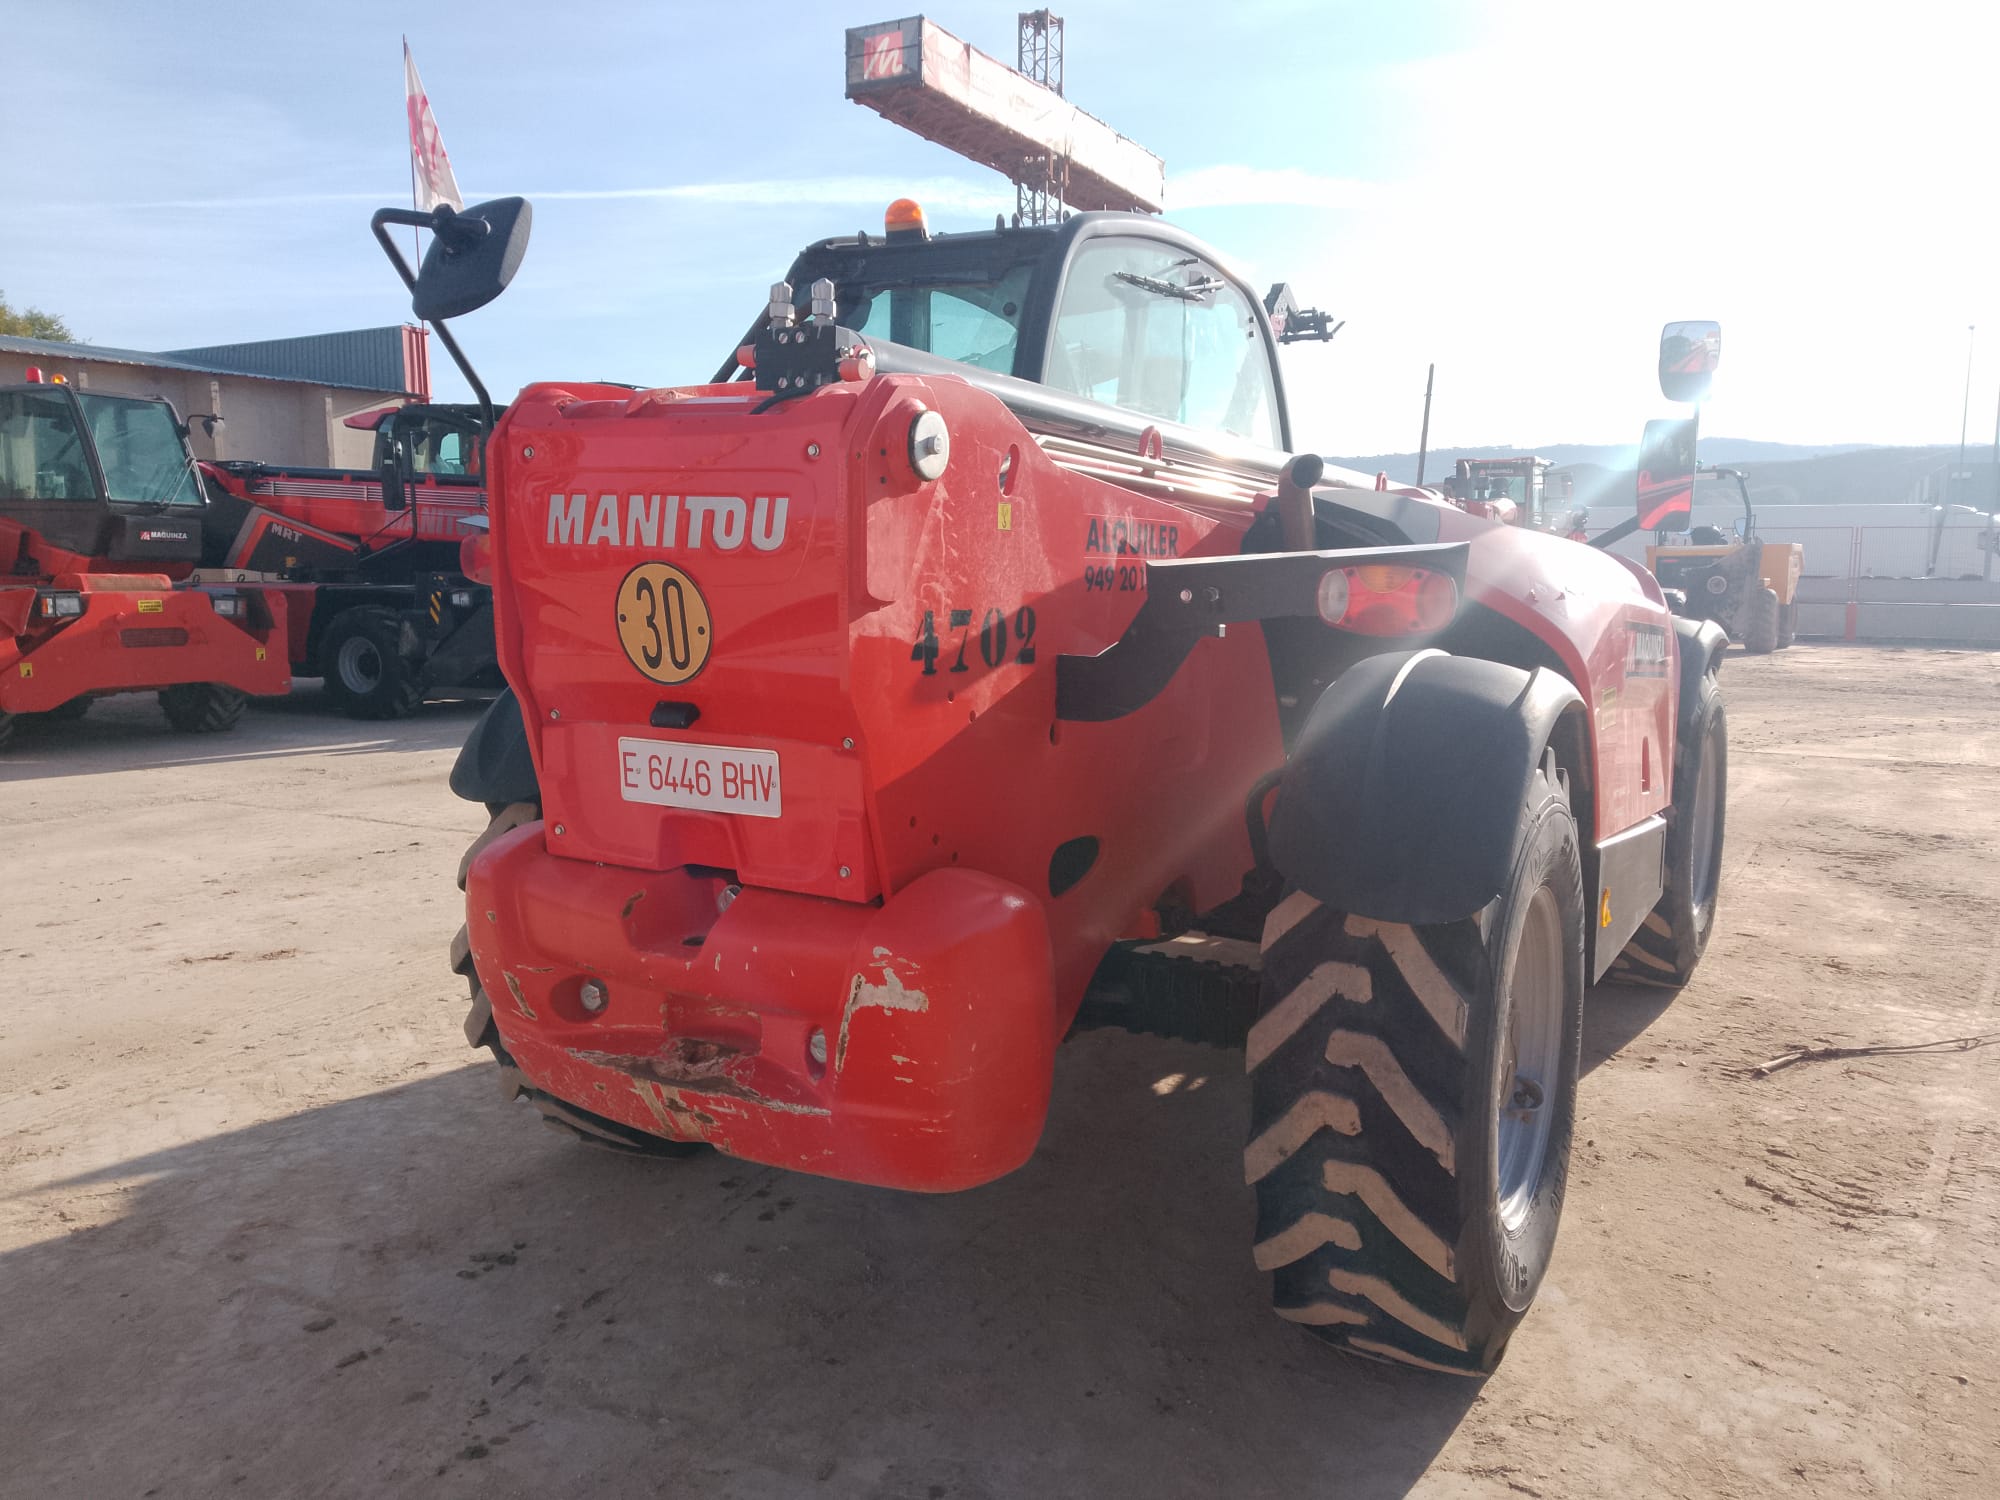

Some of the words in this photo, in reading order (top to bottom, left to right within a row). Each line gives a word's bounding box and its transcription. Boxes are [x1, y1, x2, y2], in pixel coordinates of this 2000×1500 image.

[271, 523, 302, 542] MRT
[547, 494, 789, 551] MANITOU
[1086, 518, 1178, 555] ALQUILER
[1085, 566, 1114, 592] 949
[637, 577, 690, 670] 30
[911, 605, 1036, 675] 4702
[622, 751, 639, 788] E
[648, 755, 712, 797] 6446
[722, 761, 773, 802] BHV
